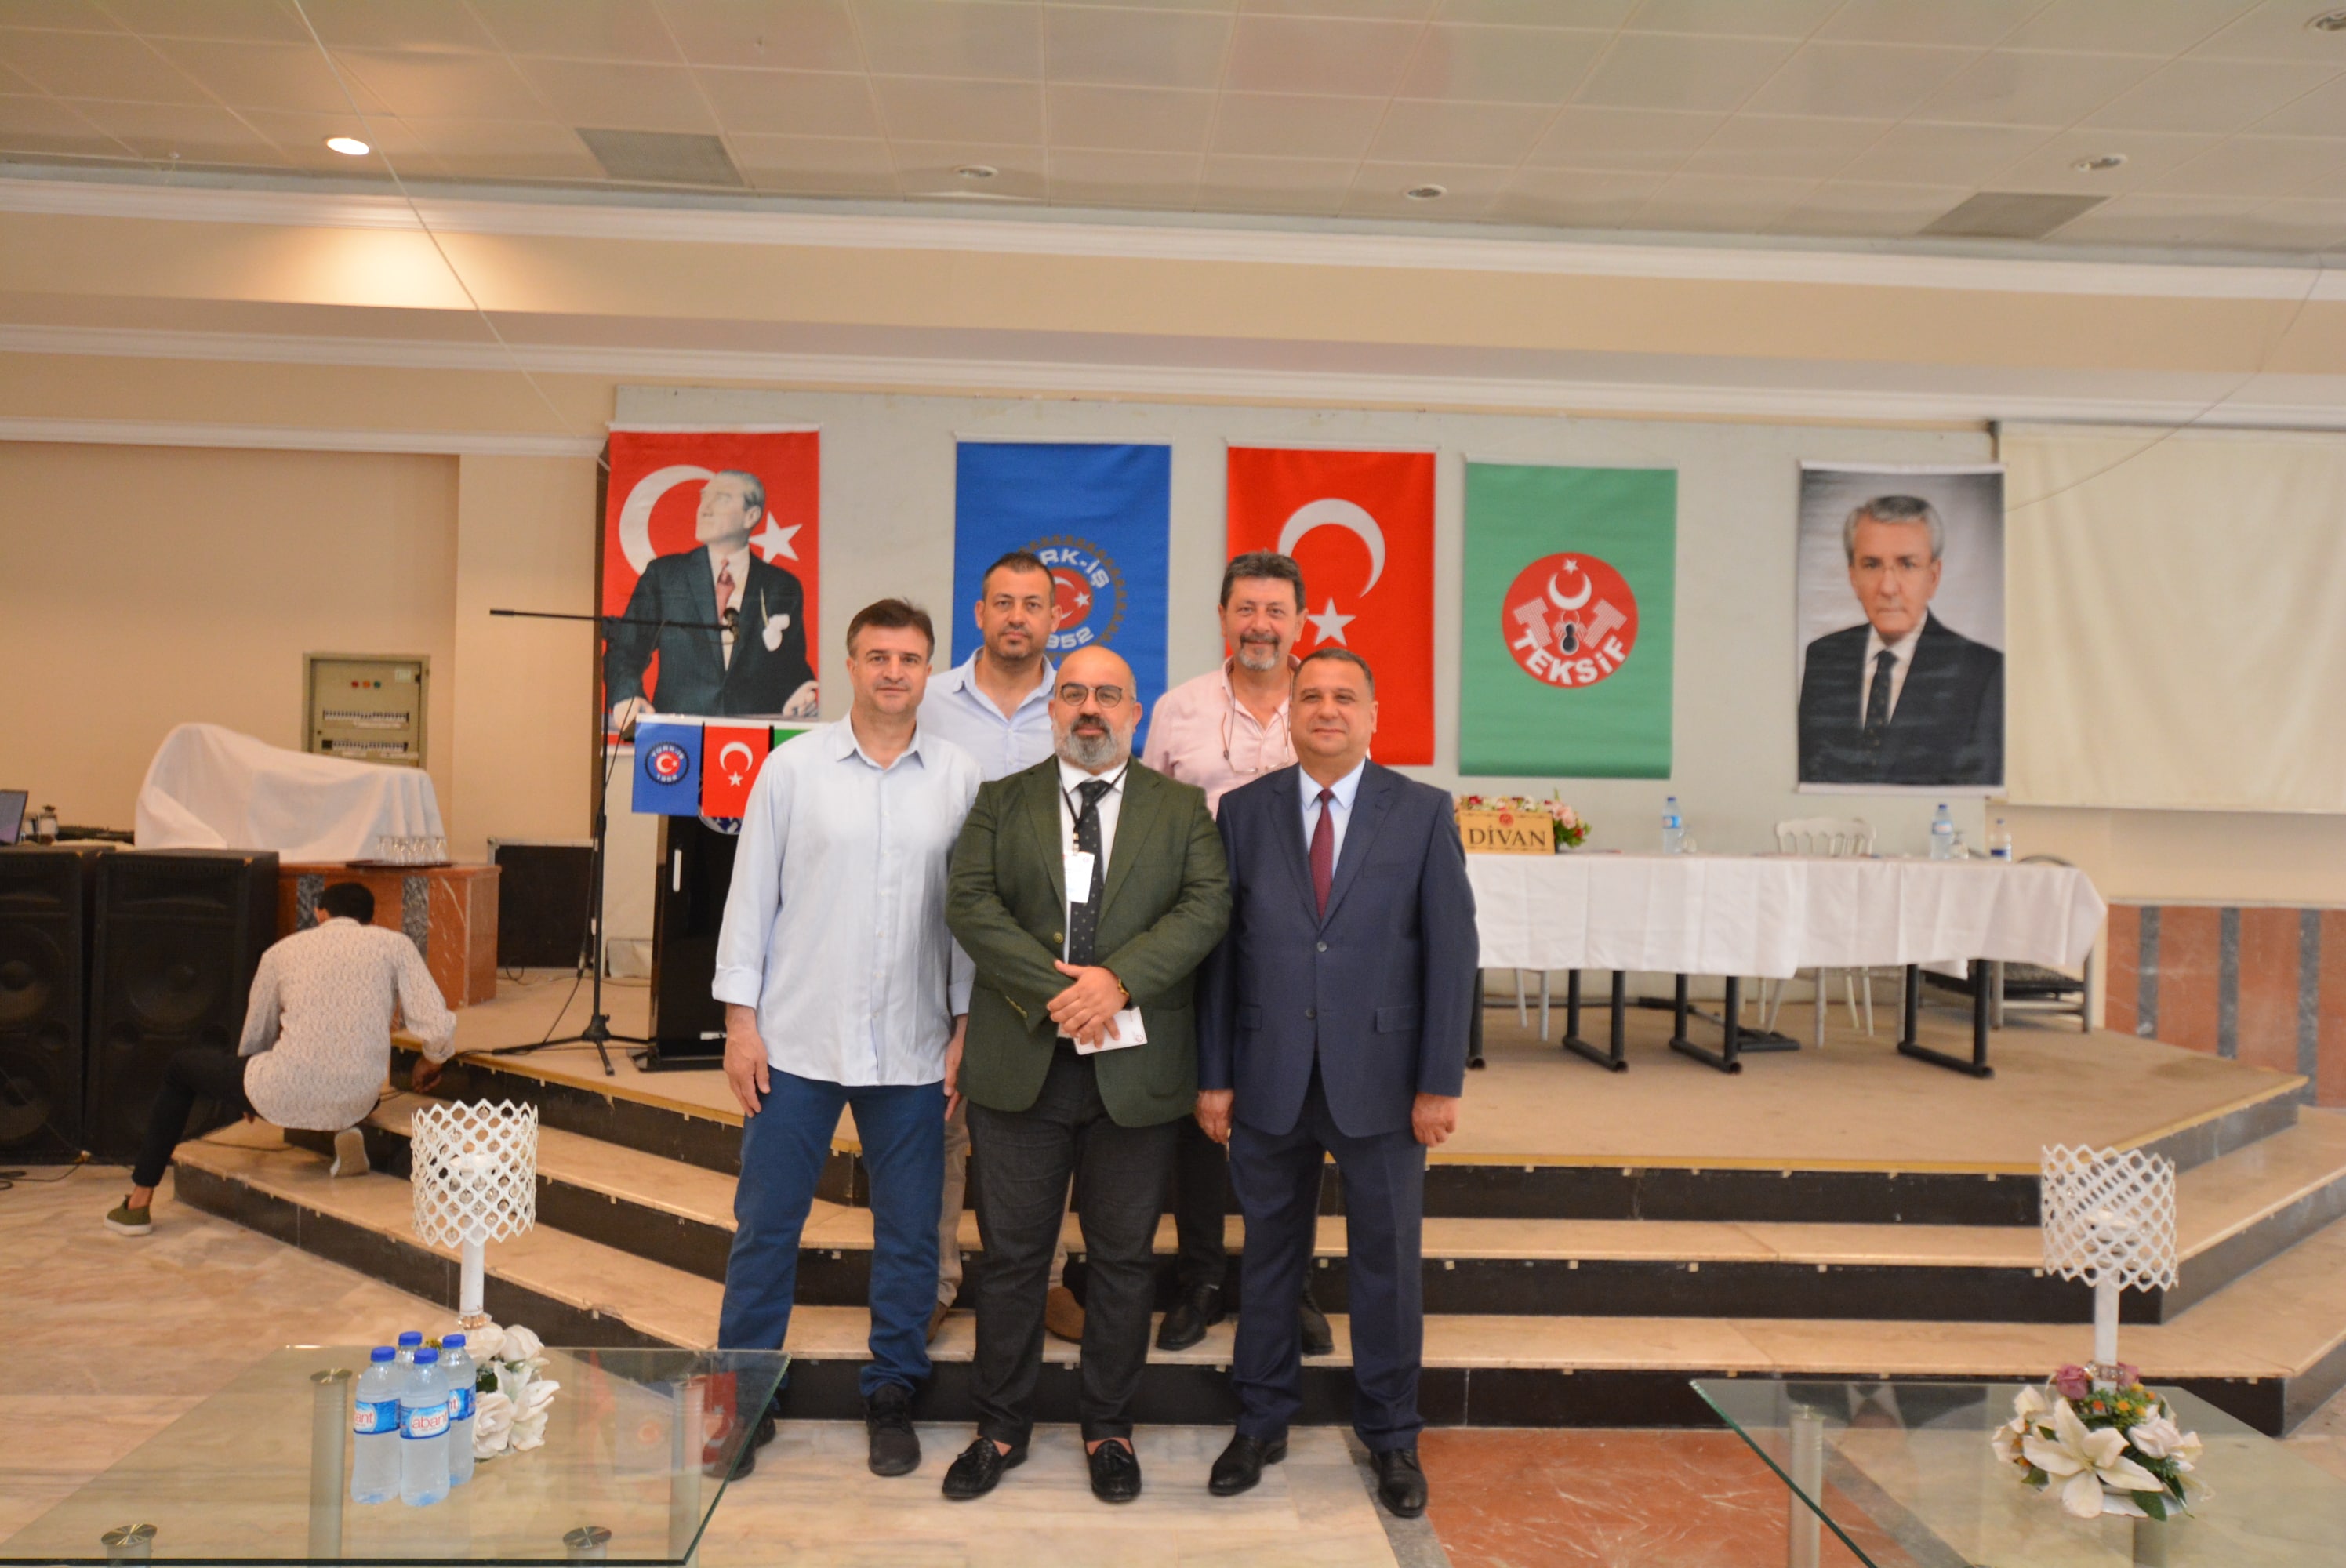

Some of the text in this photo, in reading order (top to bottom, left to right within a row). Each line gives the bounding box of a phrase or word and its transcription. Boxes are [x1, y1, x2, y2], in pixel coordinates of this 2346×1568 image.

[1040, 548, 1110, 588] RK-İŞ
[1047, 626, 1095, 649] 952
[1469, 825, 1546, 846] DİVAN
[412, 1411, 448, 1429] abant
